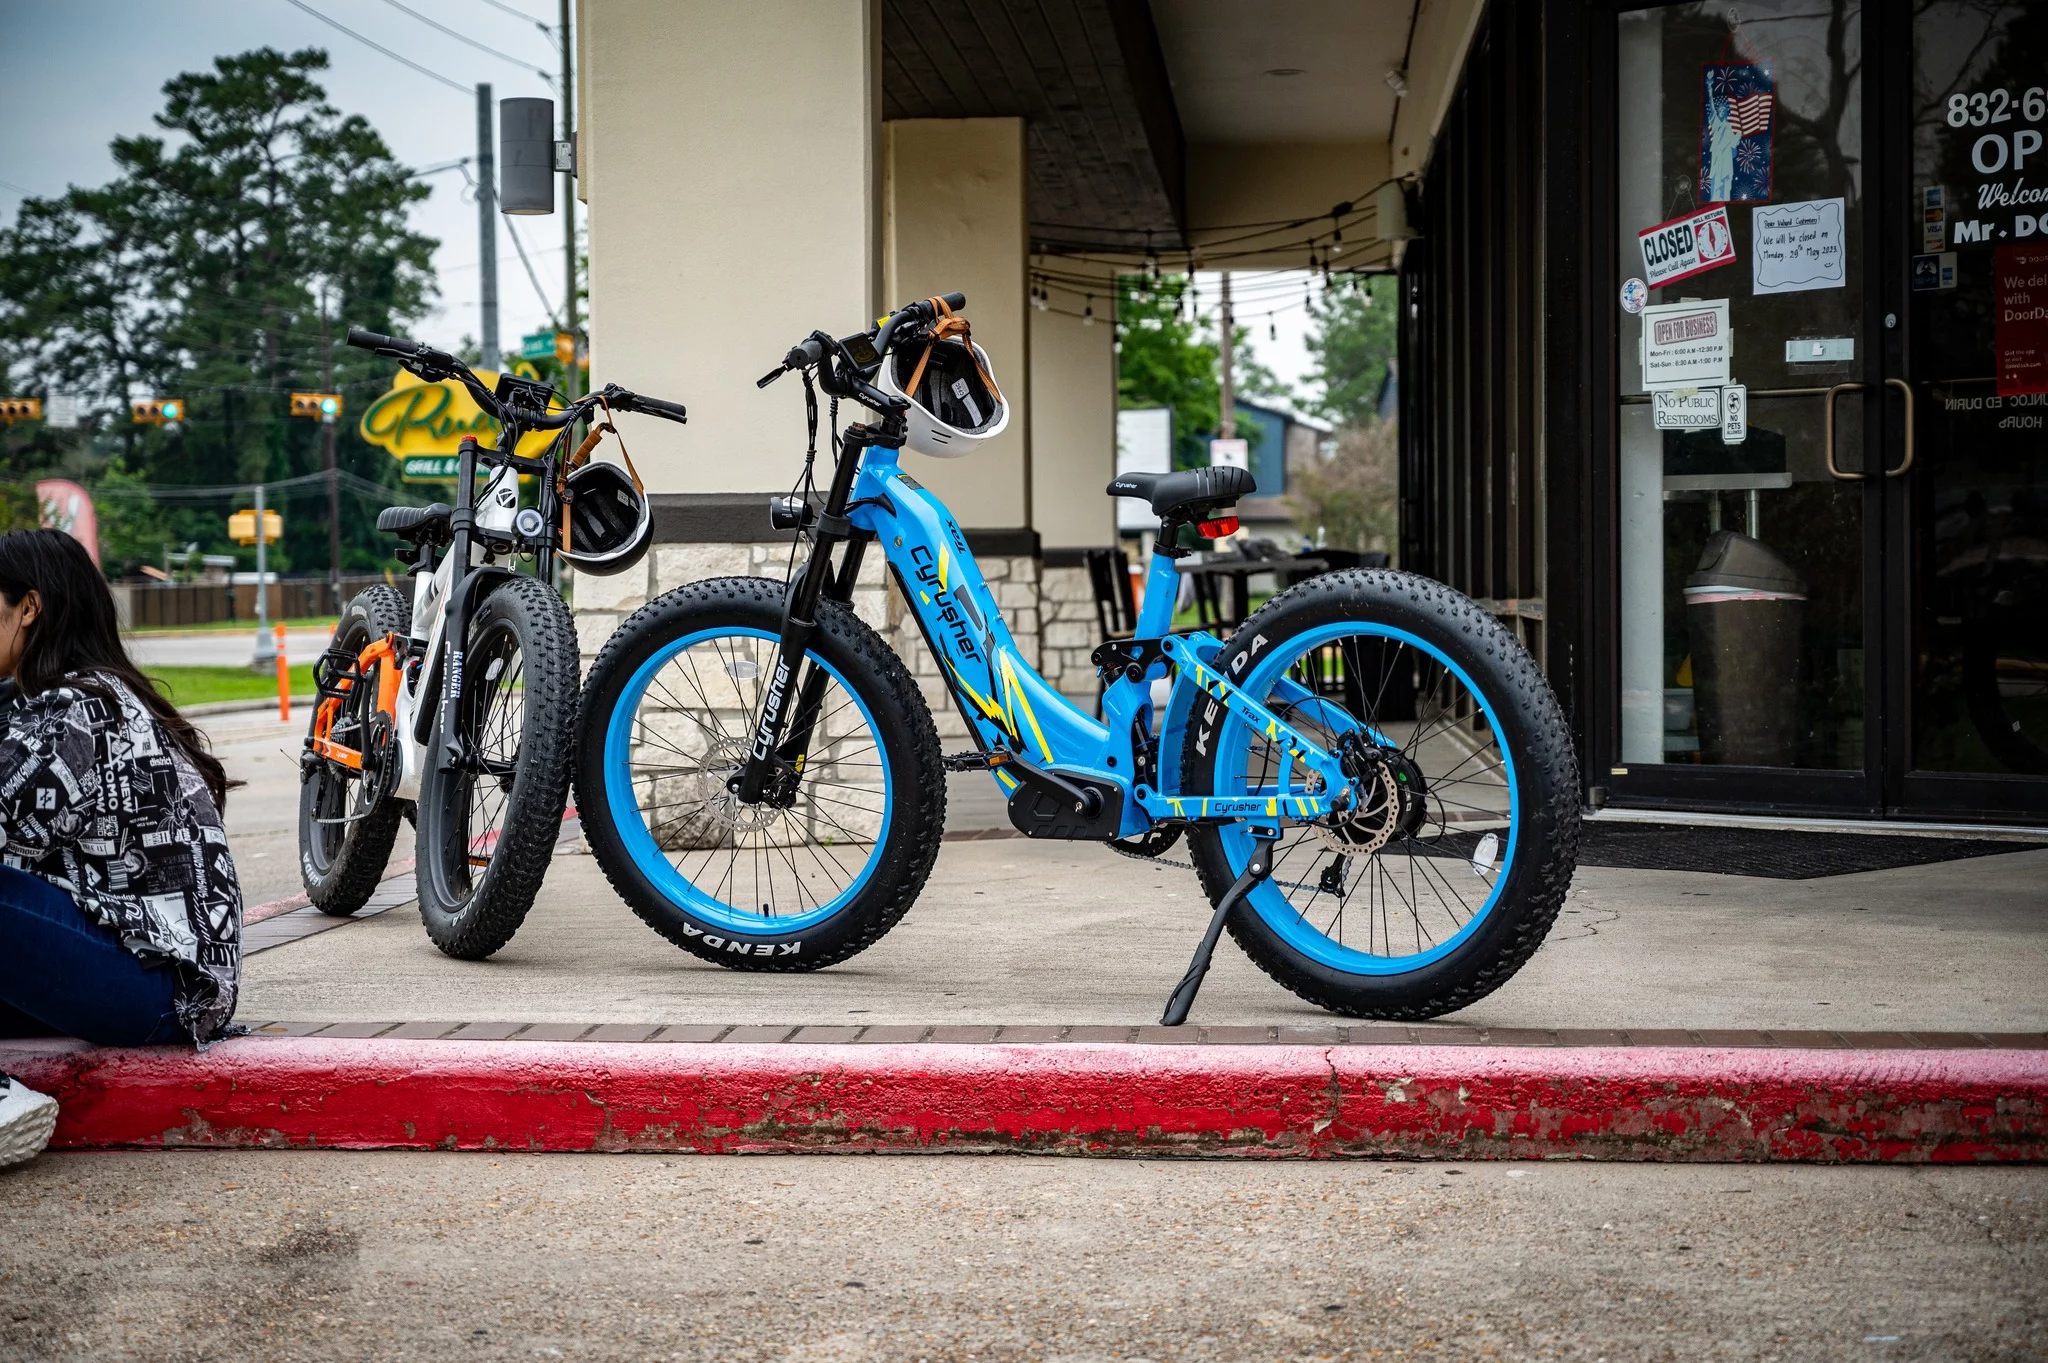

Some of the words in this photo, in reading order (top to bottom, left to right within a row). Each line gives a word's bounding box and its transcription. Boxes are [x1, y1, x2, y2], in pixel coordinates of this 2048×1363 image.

[1704, 209, 1724, 220] RETURN
[1927, 225, 1943, 233] VISA
[1643, 224, 1694, 267] CLOSED
[1763, 236, 1773, 246] We
[1776, 233, 1786, 244] will
[1788, 232, 1795, 243] be
[1799, 230, 1817, 243] closed
[1806, 247, 1820, 261] May
[1649, 267, 1667, 279] Please
[1668, 263, 1679, 272] Call
[1679, 257, 1696, 269] Again
[2004, 276, 2025, 289] We
[2004, 291, 2031, 305] with
[1657, 323, 1673, 342] OPEN
[1673, 320, 1685, 339] FOR
[1684, 315, 1714, 338] BUSINESS
[1650, 349, 1671, 357] Mon-Fri
[1729, 414, 1738, 422] NO
[1727, 422, 1741, 430] PETS
[405, 459, 441, 474] GRILL
[1115, 481, 1138, 490] Cyrusher
[945, 518, 967, 555] Trax
[910, 545, 982, 664] Cyrusher
[450, 650, 463, 698] RANGER
[752, 654, 793, 762] Cyrusher
[1241, 705, 1260, 724] Trax
[149, 756, 173, 767] district
[119, 775, 134, 814] NEW
[1214, 803, 1262, 814] Cyrusher
[20, 824, 36, 839] key
[683, 921, 802, 957] KENDA
